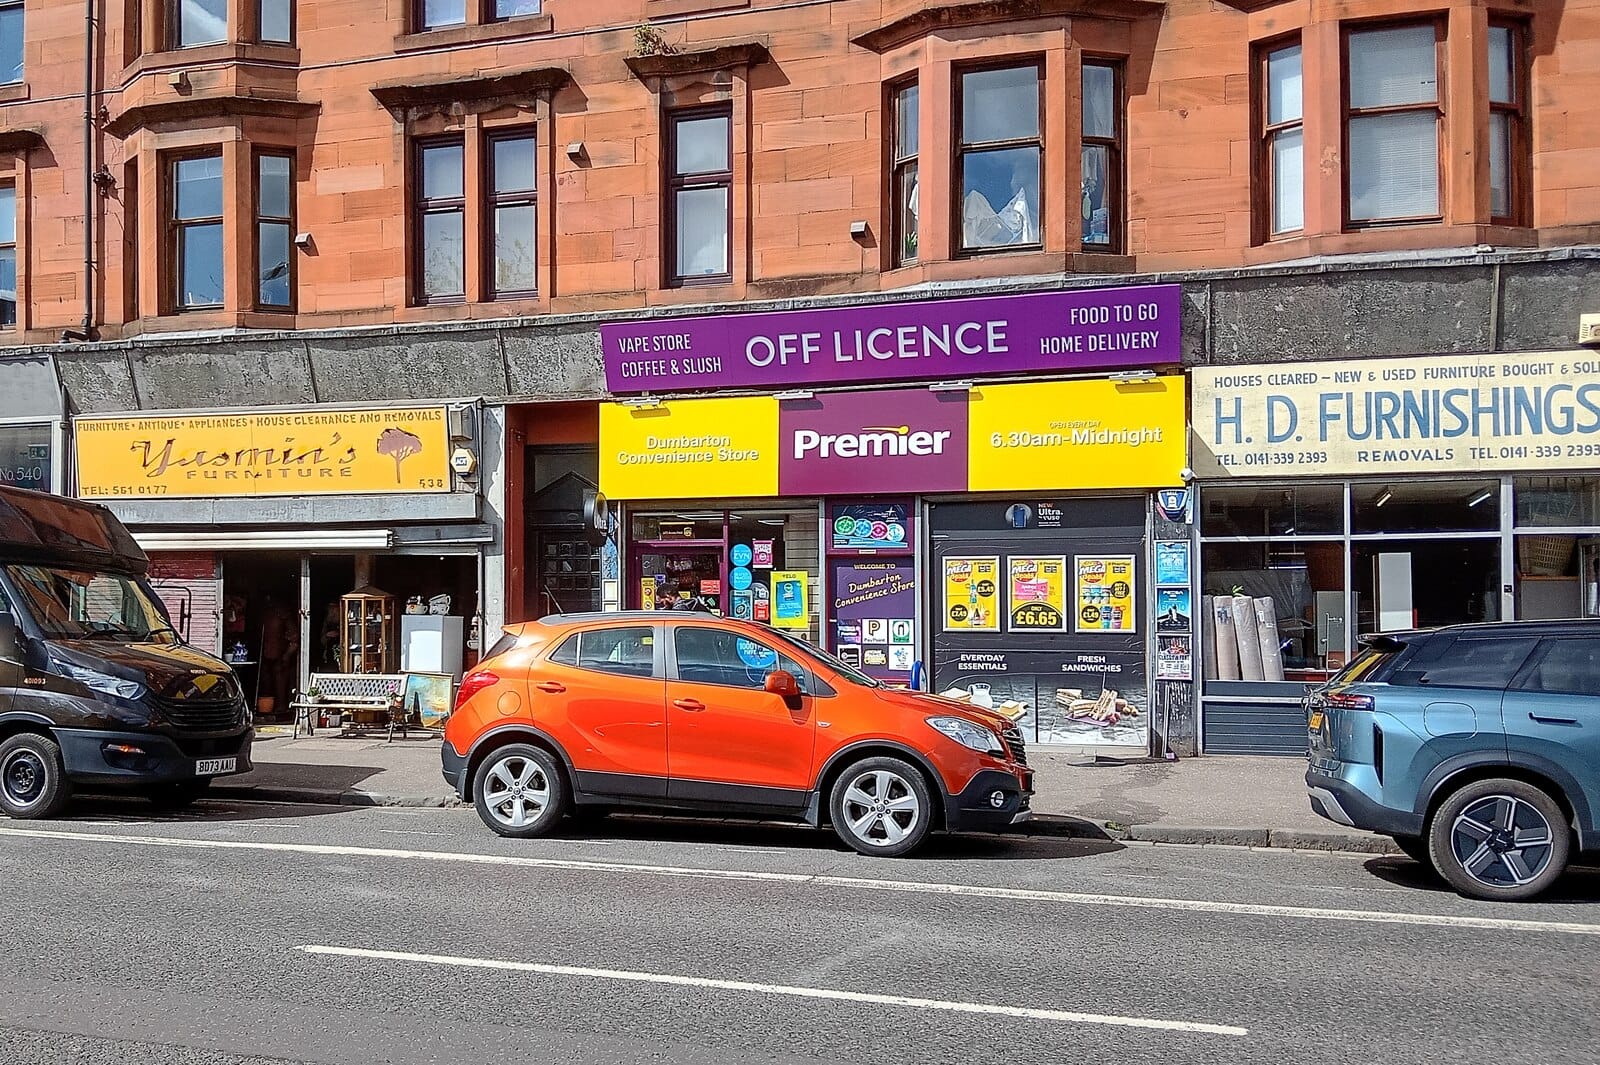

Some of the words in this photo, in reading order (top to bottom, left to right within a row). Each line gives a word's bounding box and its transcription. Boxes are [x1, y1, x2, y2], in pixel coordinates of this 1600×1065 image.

[1070, 306, 1109, 325] FOOD
[1113, 304, 1132, 322] TO
[1138, 303, 1158, 321] GO
[618, 336, 650, 353] VAPE
[653, 334, 691, 351] STORE
[745, 332, 821, 367] OFF
[833, 320, 1009, 362] LICENCE
[1040, 336, 1083, 354] HOME
[1088, 331, 1159, 352] DELIVERY
[621, 360, 667, 378] COFFEE
[670, 359, 680, 375] &
[683, 356, 722, 374] SLUSH
[1214, 375, 1263, 388] HOUSES
[1267, 372, 1318, 386] CLEARED
[1334, 370, 1362, 383] NEW
[1368, 371, 1376, 382] &
[1382, 369, 1417, 381] USED
[1424, 365, 1496, 380] FURNITURE
[1502, 362, 1555, 377] BOUGHT
[1560, 363, 1569, 375] &
[1573, 361, 1600, 374] SOL
[77, 422, 131, 432] FURNITURE
[138, 420, 180, 431] ANTIQUE
[189, 417, 248, 429] APPLIANCES
[256, 415, 292, 427] HOUSE
[294, 414, 357, 426] CLEARANCE
[359, 413, 381, 424] AND
[385, 410, 442, 423] REMOVALS
[1215, 396, 1253, 445] H.
[1266, 394, 1303, 443] D.
[1319, 383, 1600, 442] FURNISHINGS
[1049, 421, 1067, 429] OPEN
[1067, 421, 1088, 429] EVERY
[1088, 420, 1101, 428] DAY
[646, 435, 731, 449] Dumbarton
[794, 425, 950, 459] Premier
[990, 426, 1163, 447] 6.30am-Midnight
[130, 431, 358, 478] Yasmin's
[618, 450, 713, 465] Convenience
[717, 447, 759, 461] Store
[1298, 451, 1328, 464] 2393
[1357, 448, 1454, 463] REMOVALS
[1567, 444, 1600, 457] 2393
[16, 466, 42, 481] 540
[186, 466, 353, 479] FURNITURE
[82, 486, 109, 495] TEL:
[112, 486, 133, 495] 561
[138, 485, 168, 494] 0177
[419, 478, 443, 489] 538
[848, 573, 902, 593] Dumbarton
[834, 588, 889, 609] Convenience
[890, 580, 915, 594] Store
[1015, 610, 1057, 626] £6.65
[960, 654, 1005, 662] EVERYDAY
[1077, 655, 1106, 663] FRESH
[958, 662, 1007, 671] ESSENTIALS
[1061, 664, 1122, 673] SANDWICHES
[220, 759, 234, 771] AAU
